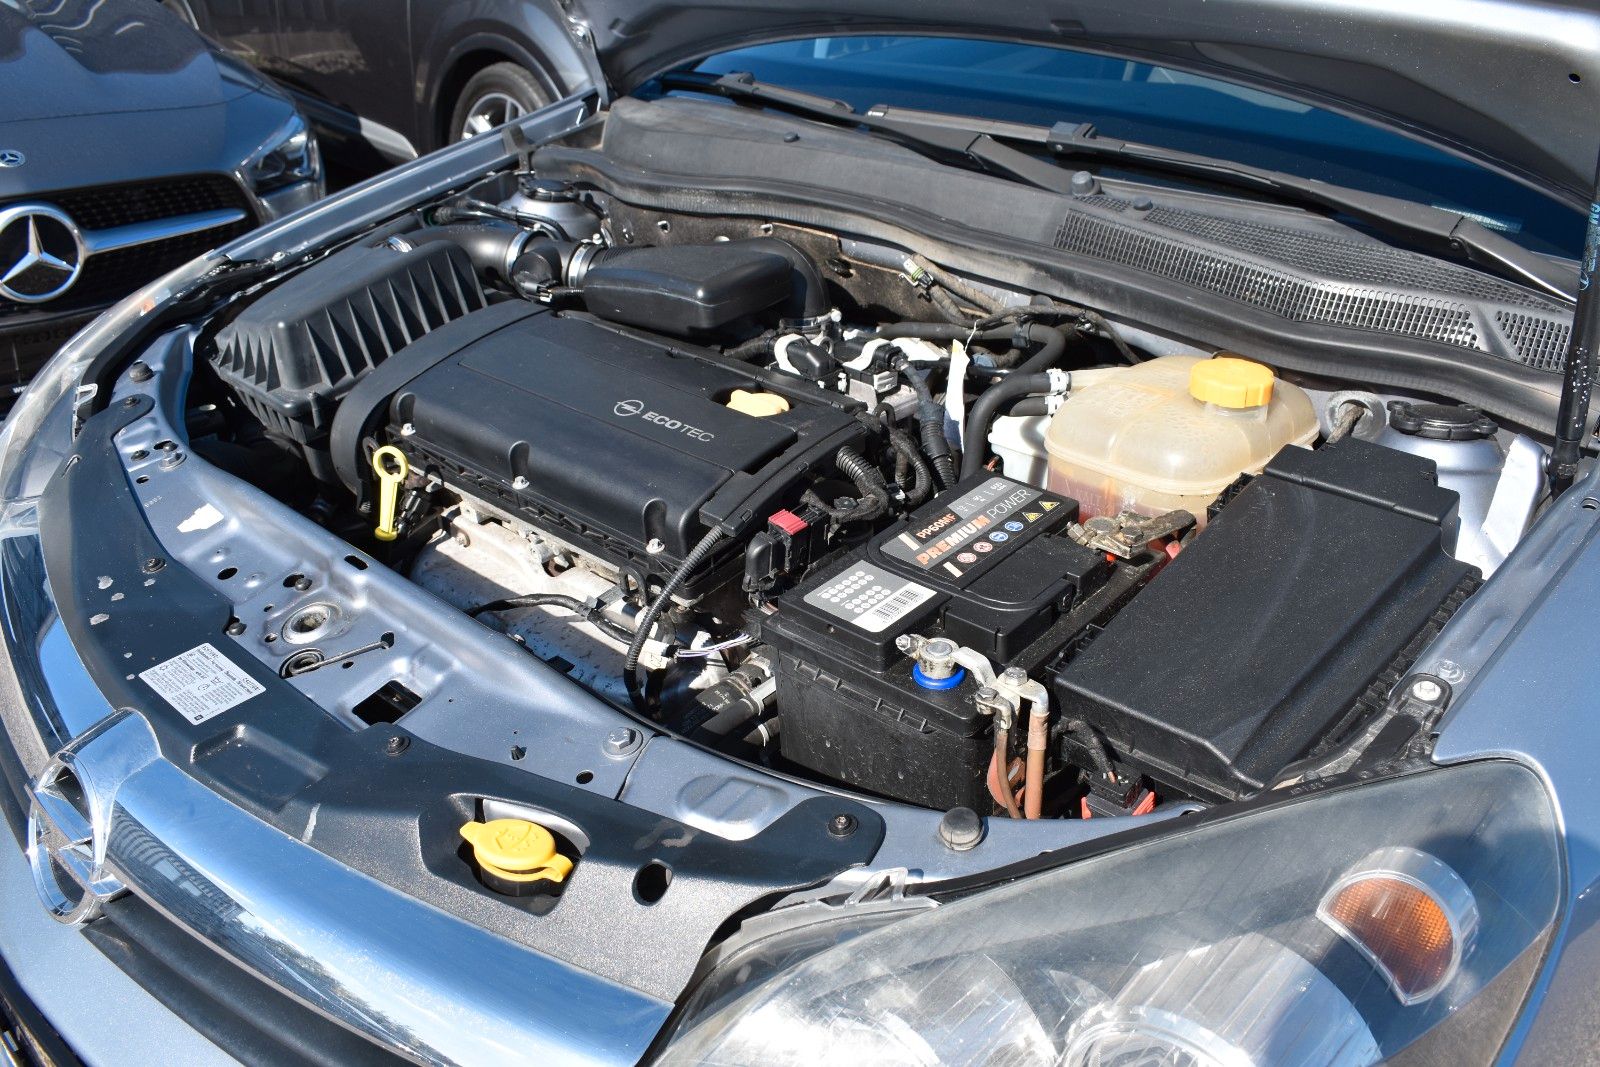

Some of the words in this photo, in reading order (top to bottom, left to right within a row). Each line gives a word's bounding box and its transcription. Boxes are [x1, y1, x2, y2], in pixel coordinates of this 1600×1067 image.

[642, 411, 715, 442] ECOTEC
[915, 514, 992, 565] PREMIUM
[986, 489, 1032, 519] POWER
